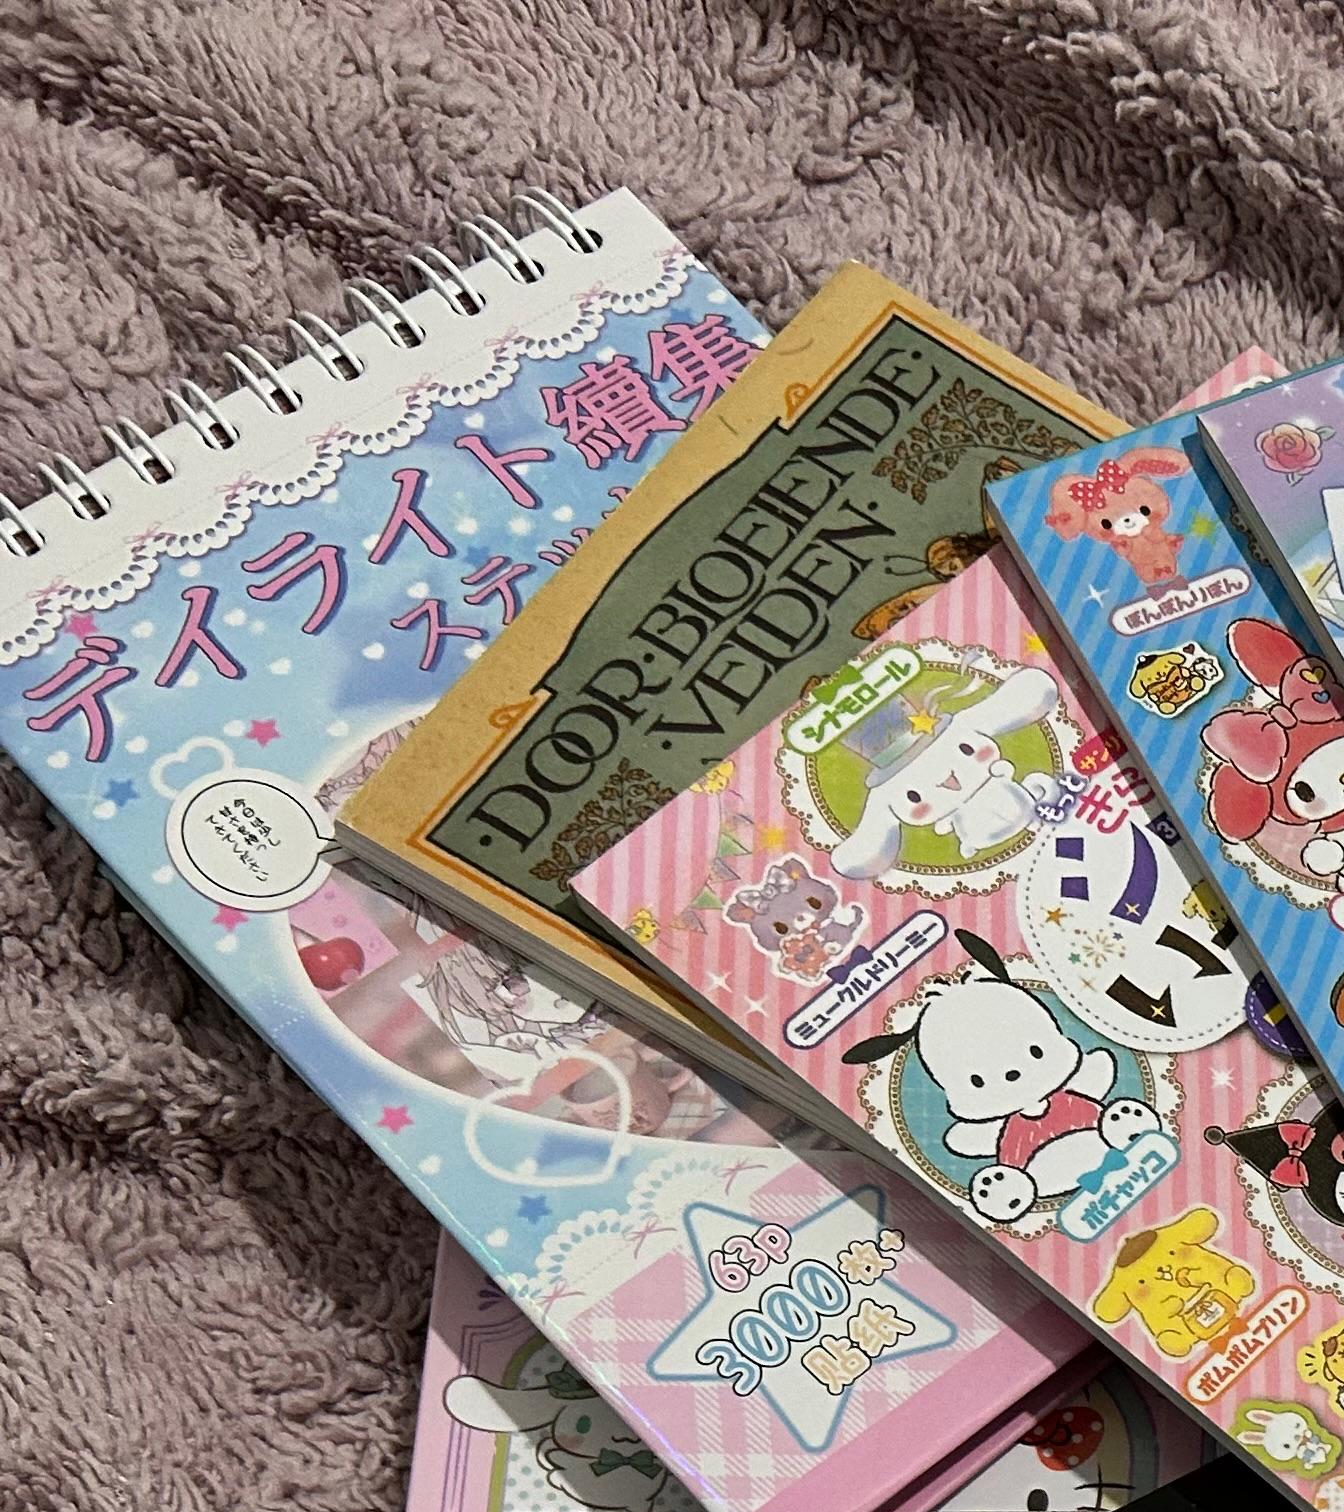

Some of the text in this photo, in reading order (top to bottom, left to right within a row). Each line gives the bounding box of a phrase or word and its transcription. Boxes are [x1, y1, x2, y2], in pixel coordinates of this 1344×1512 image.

[802, 657, 912, 743] シナモロール
[1080, 1152, 1167, 1231] ポチャッコ
[1196, 1294, 1301, 1396] ポムポムプリン
